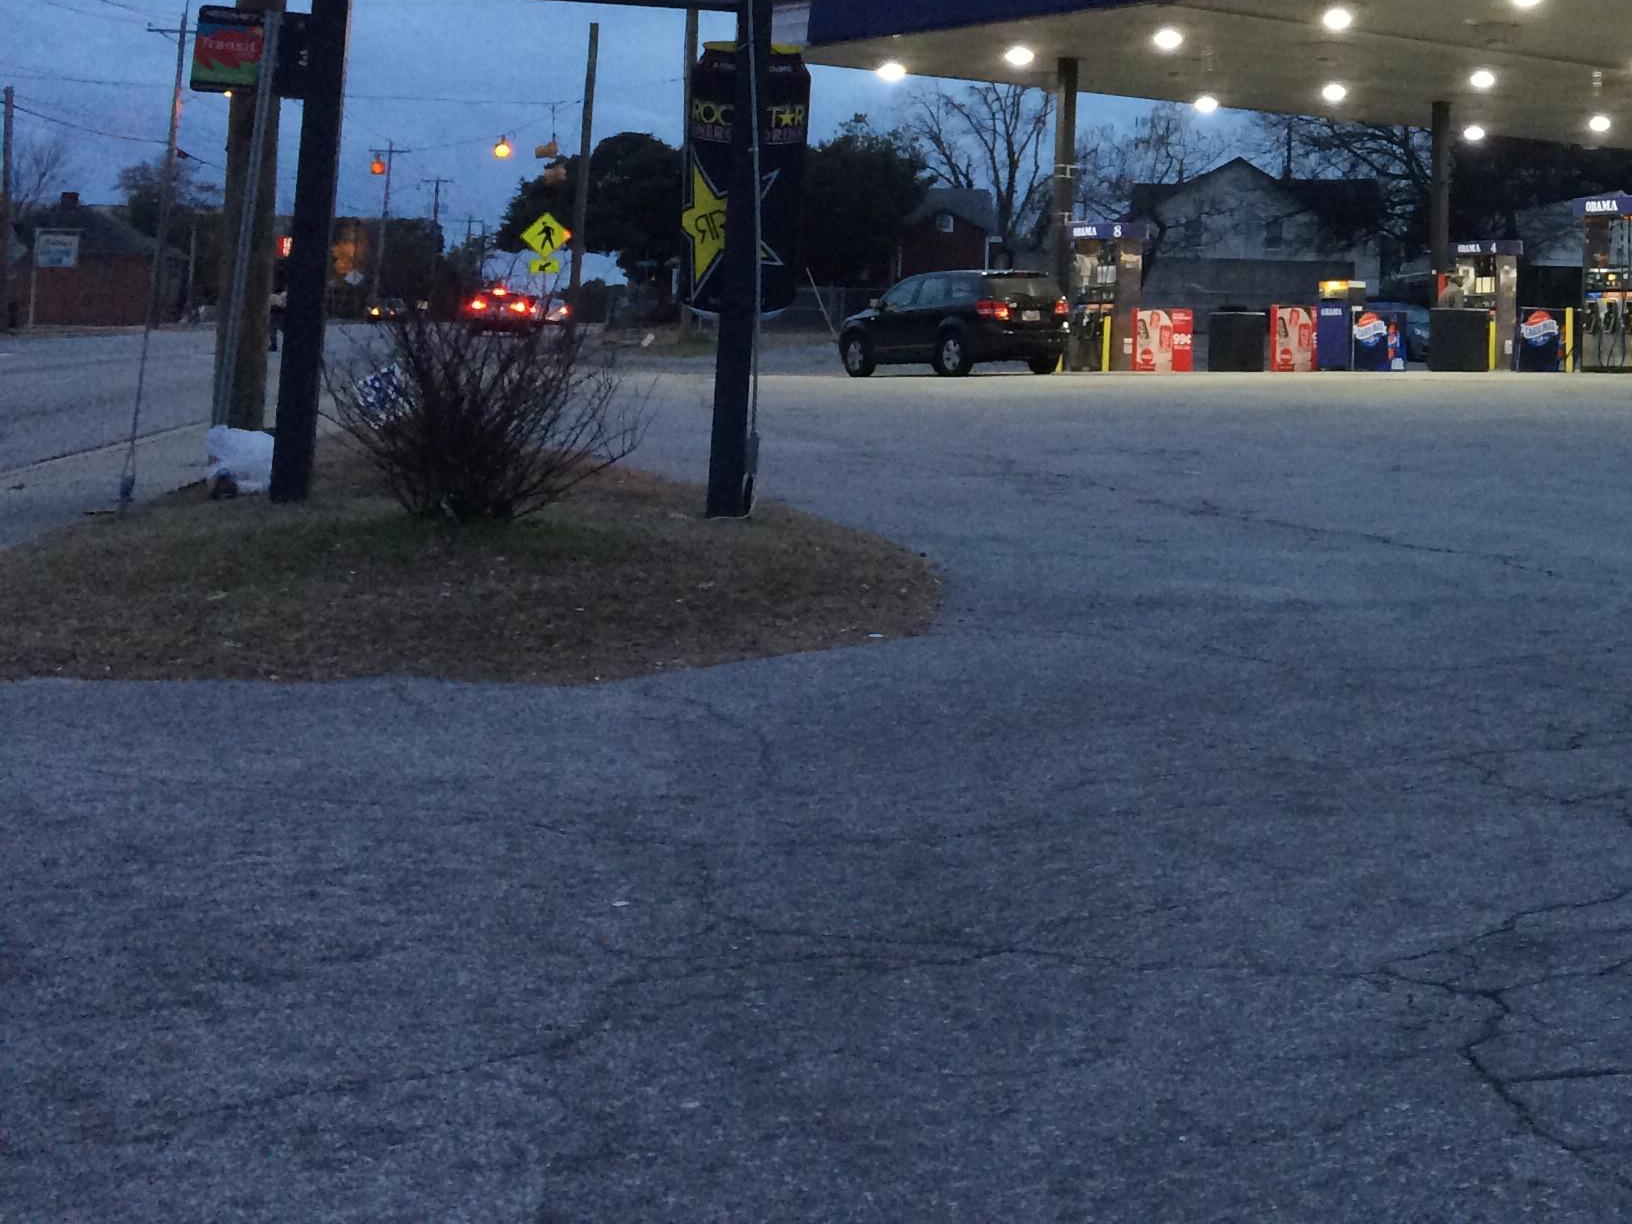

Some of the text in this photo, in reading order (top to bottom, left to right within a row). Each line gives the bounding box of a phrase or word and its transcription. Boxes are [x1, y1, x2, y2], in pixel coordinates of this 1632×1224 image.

[1584, 200, 1618, 213] OBAMA
[1113, 224, 1122, 238] 8
[1490, 242, 1497, 254] 4
